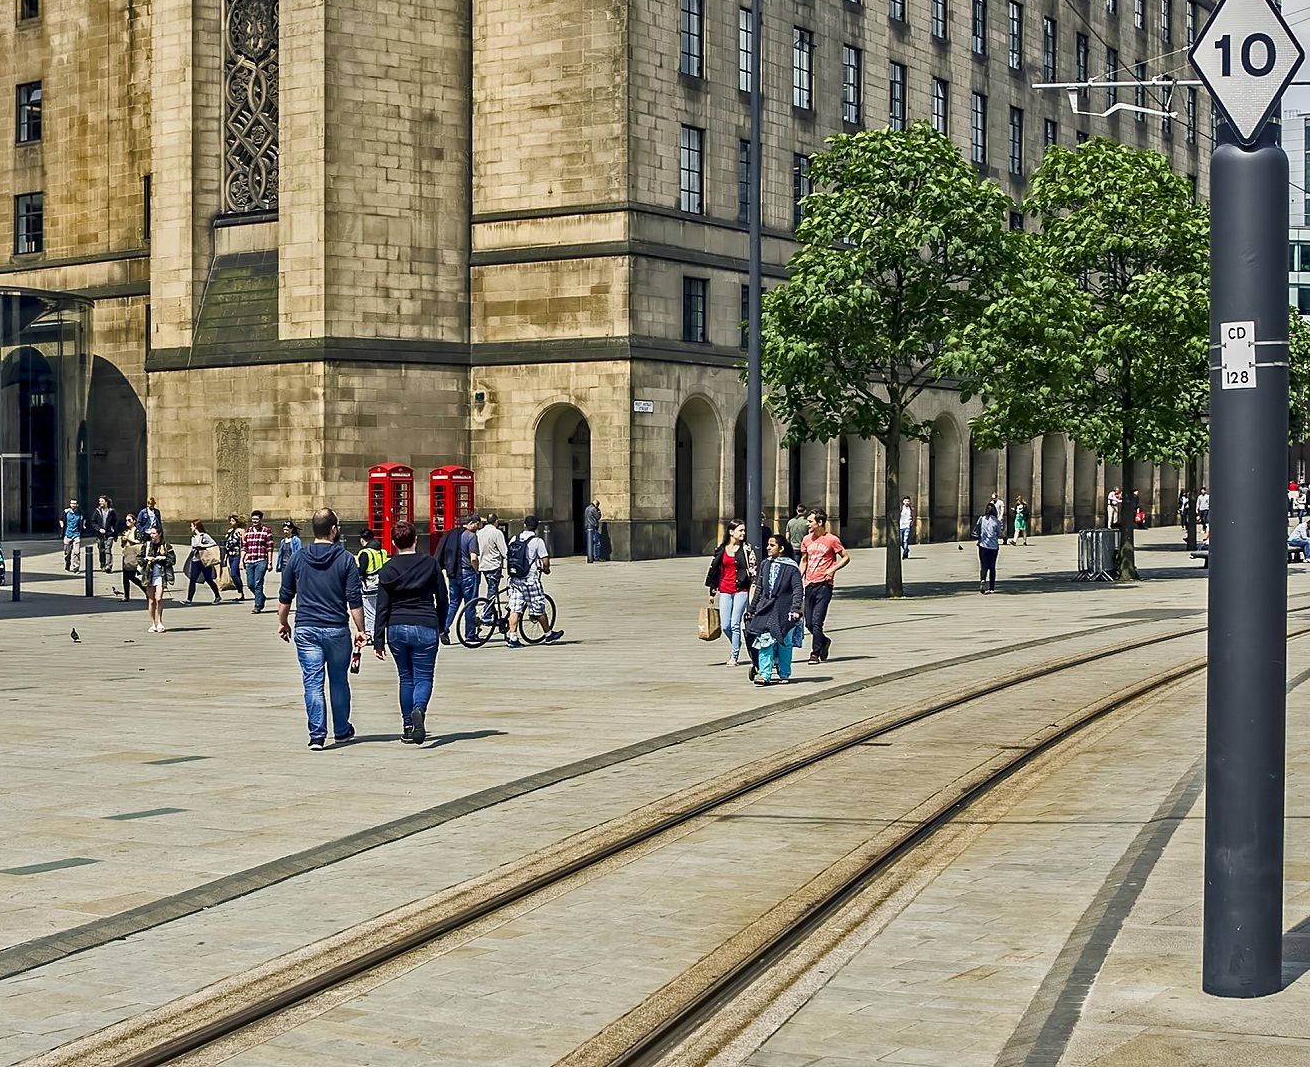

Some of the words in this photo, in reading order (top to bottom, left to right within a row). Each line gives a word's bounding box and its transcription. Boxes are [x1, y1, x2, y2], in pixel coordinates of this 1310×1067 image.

[1214, 33, 1276, 77] 10
[1228, 327, 1246, 339] CD
[1227, 370, 1249, 384] 128
